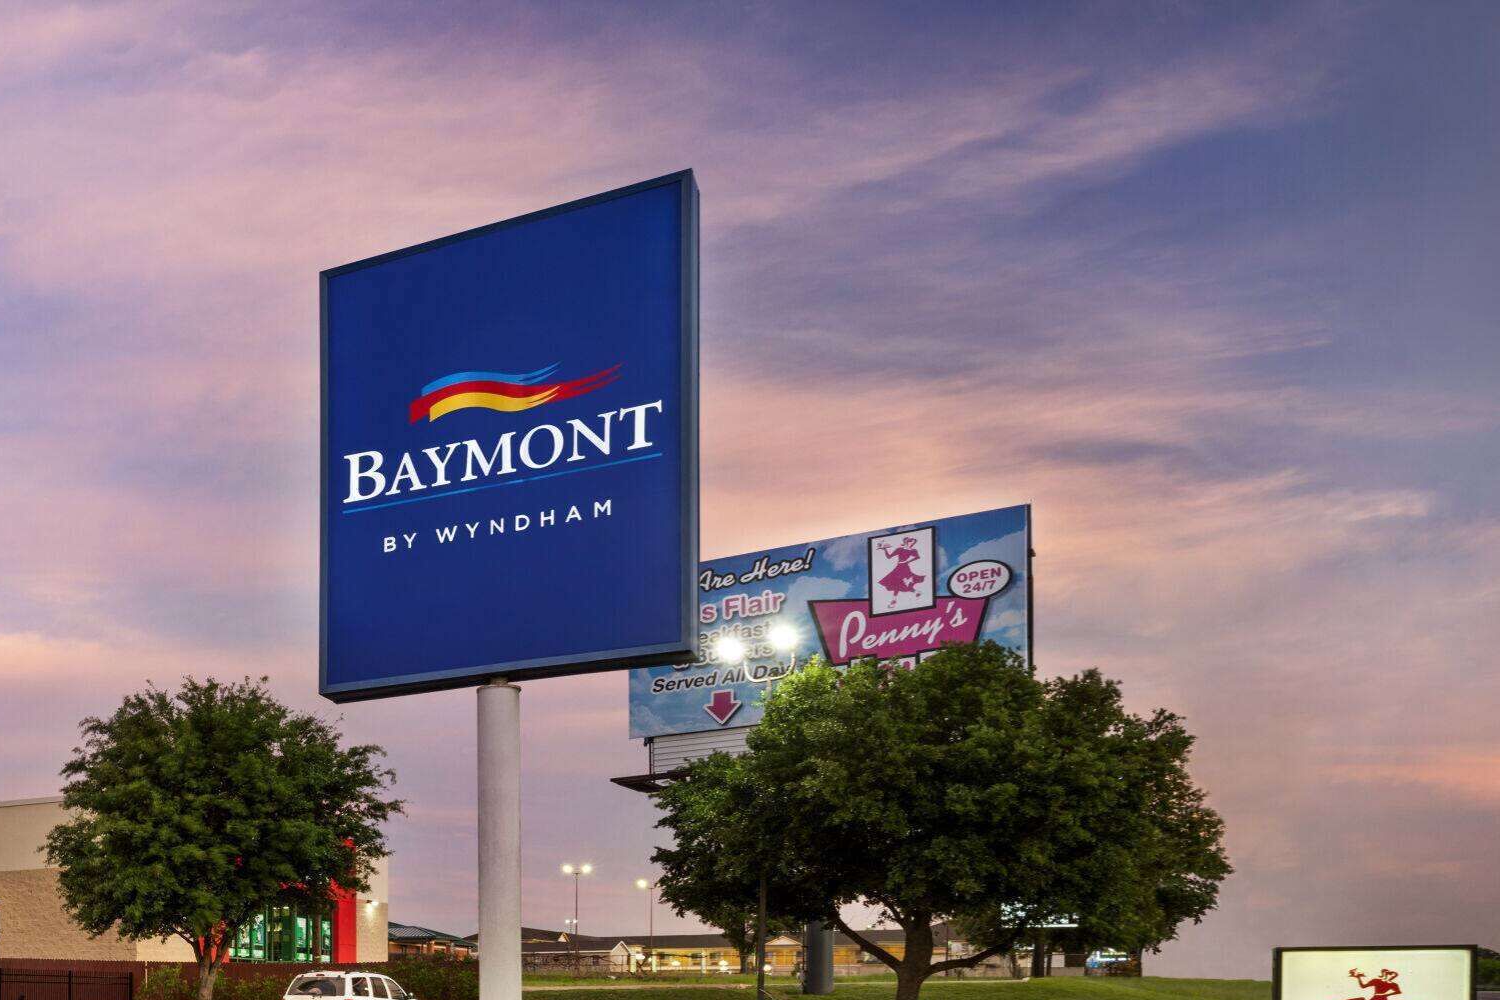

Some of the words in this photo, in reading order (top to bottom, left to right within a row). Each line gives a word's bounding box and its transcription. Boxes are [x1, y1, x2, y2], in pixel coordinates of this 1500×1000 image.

[343, 400, 662, 504] BAYMONT
[383, 533, 418, 553] BY
[436, 500, 612, 543] WYNDHAM
[739, 548, 815, 583] Here!
[956, 566, 1002, 583] OPEN
[962, 580, 997, 594] 24/7
[723, 590, 785, 619] Flair
[839, 600, 969, 658] Penny's
[652, 671, 718, 693] Served
[722, 667, 746, 685] All
